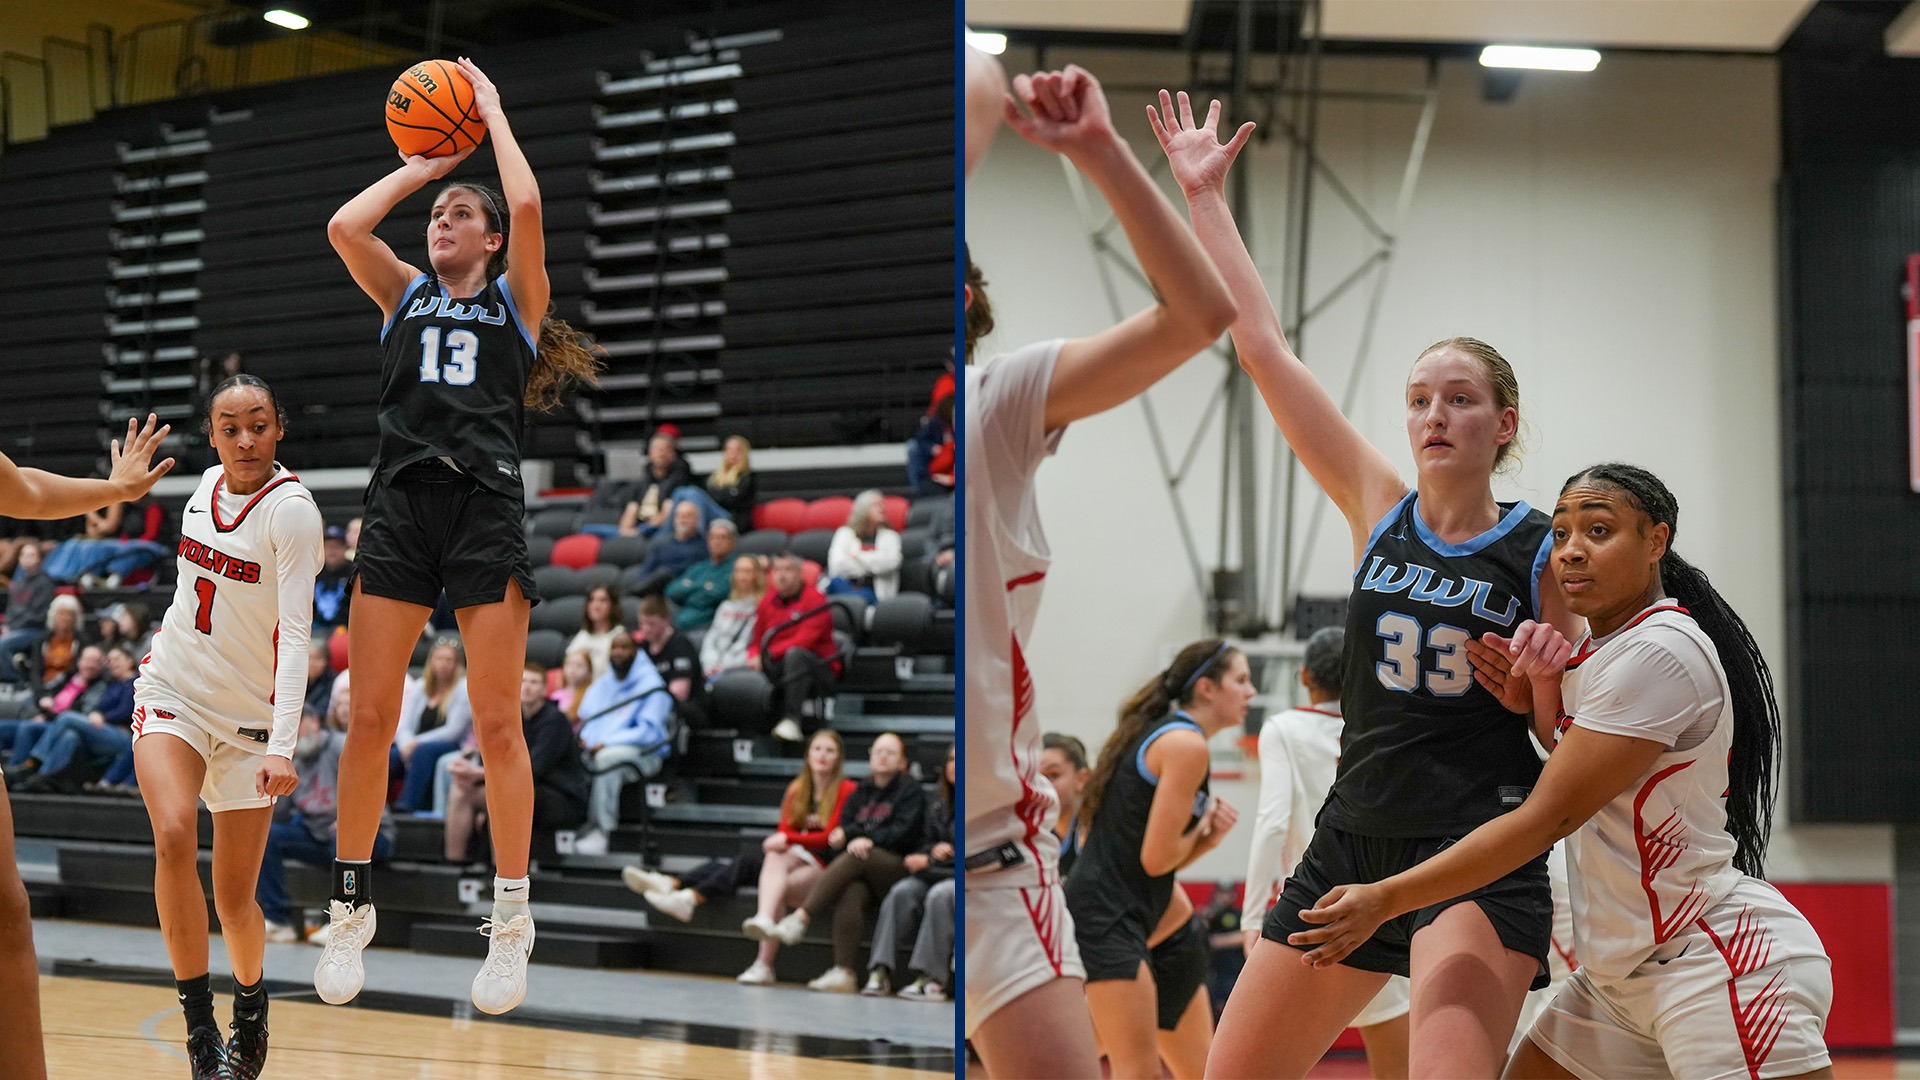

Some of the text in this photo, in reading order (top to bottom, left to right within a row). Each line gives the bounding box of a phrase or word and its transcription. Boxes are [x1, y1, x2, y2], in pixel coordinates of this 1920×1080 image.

[388, 90, 411, 113] CAA
[404, 297, 506, 326] WWU
[420, 326, 479, 386] 13
[194, 576, 216, 635] 1
[1361, 556, 1521, 627] WWU
[1375, 610, 1475, 697] 33
